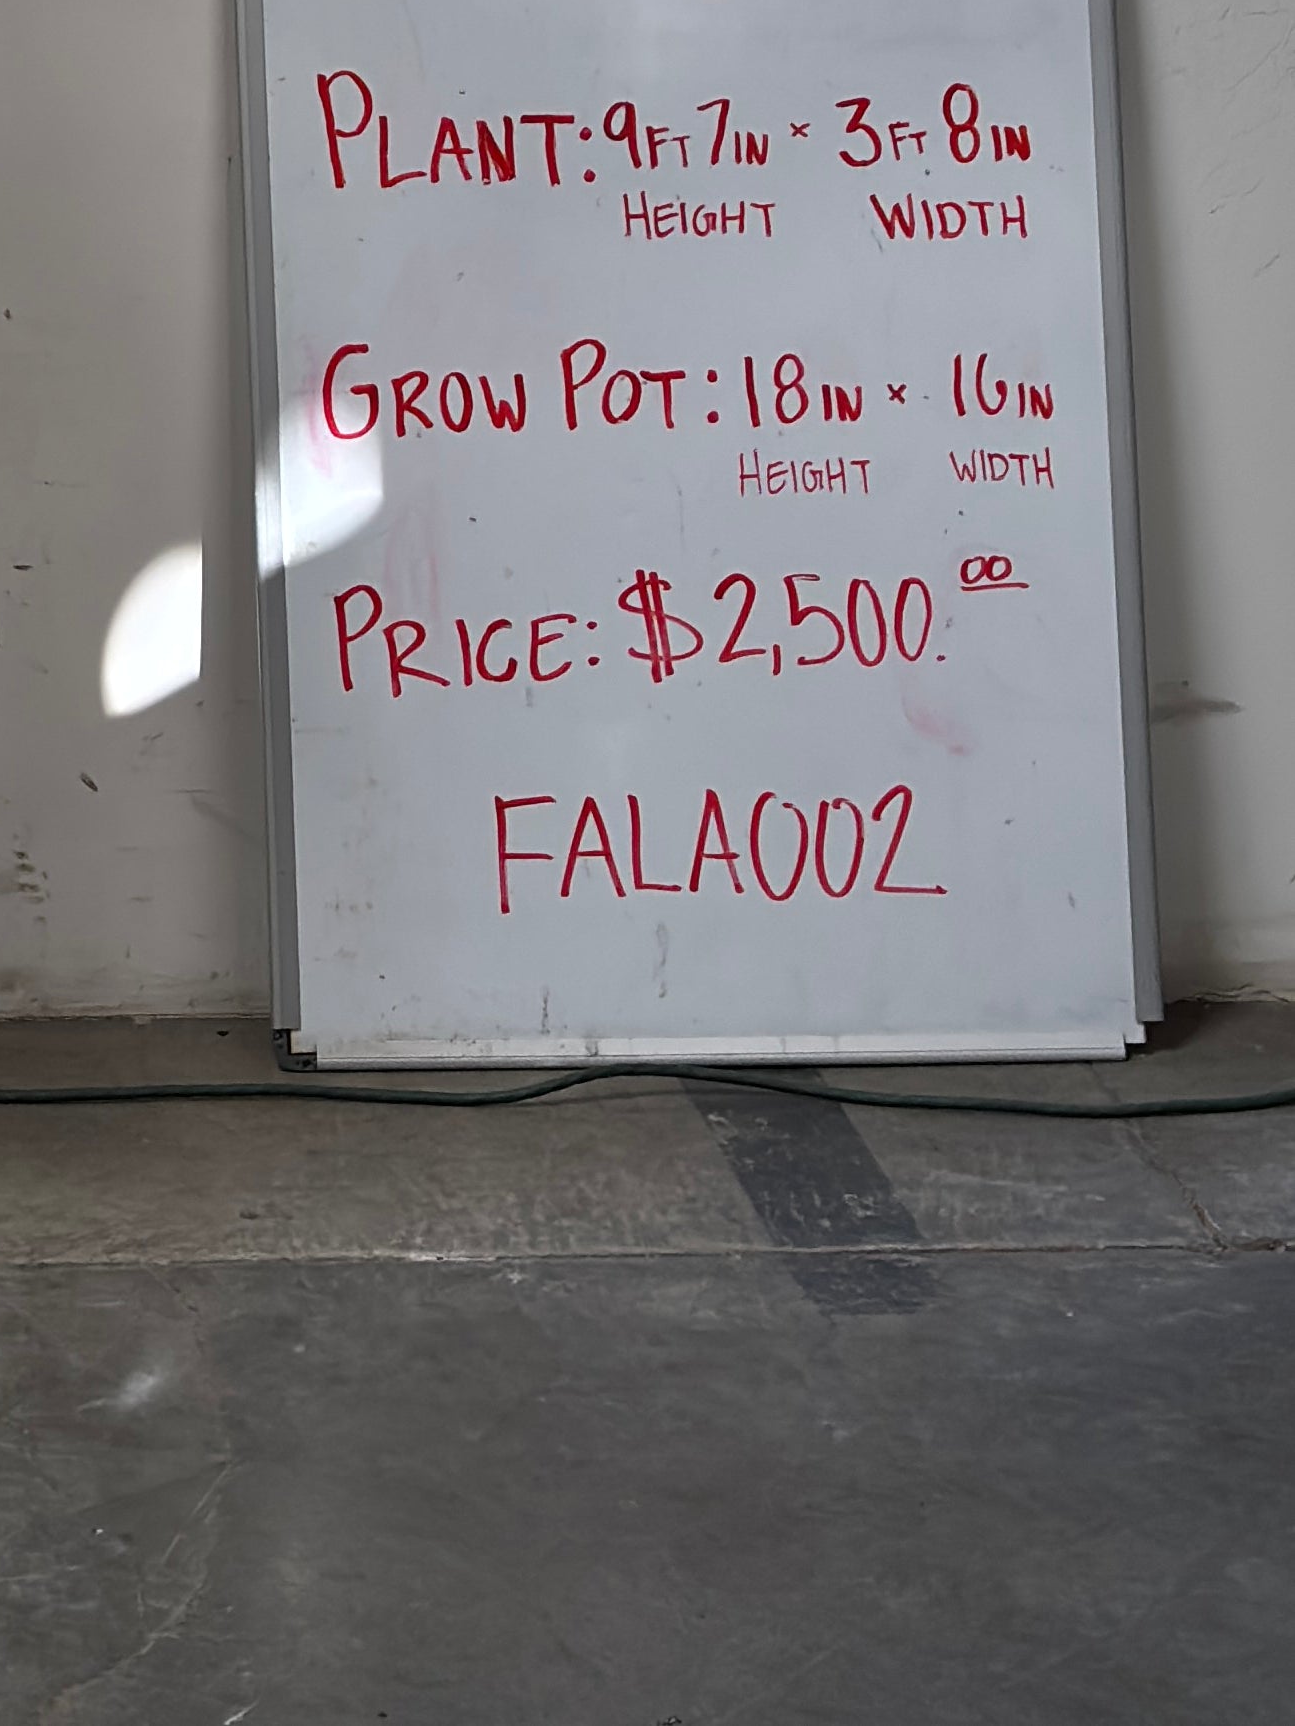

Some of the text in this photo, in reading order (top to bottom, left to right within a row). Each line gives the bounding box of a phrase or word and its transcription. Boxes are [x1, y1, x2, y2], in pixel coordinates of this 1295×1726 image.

[315, 69, 595, 190] PLANT:
[622, 192, 1028, 240] HEIGHT WIDTH
[319, 342, 528, 441] GROW
[558, 337, 720, 432] POT:
[737, 448, 1055, 497] HEIGHT WIDTH
[332, 583, 600, 700] PRICE:
[492, 783, 948, 915] FALA002
